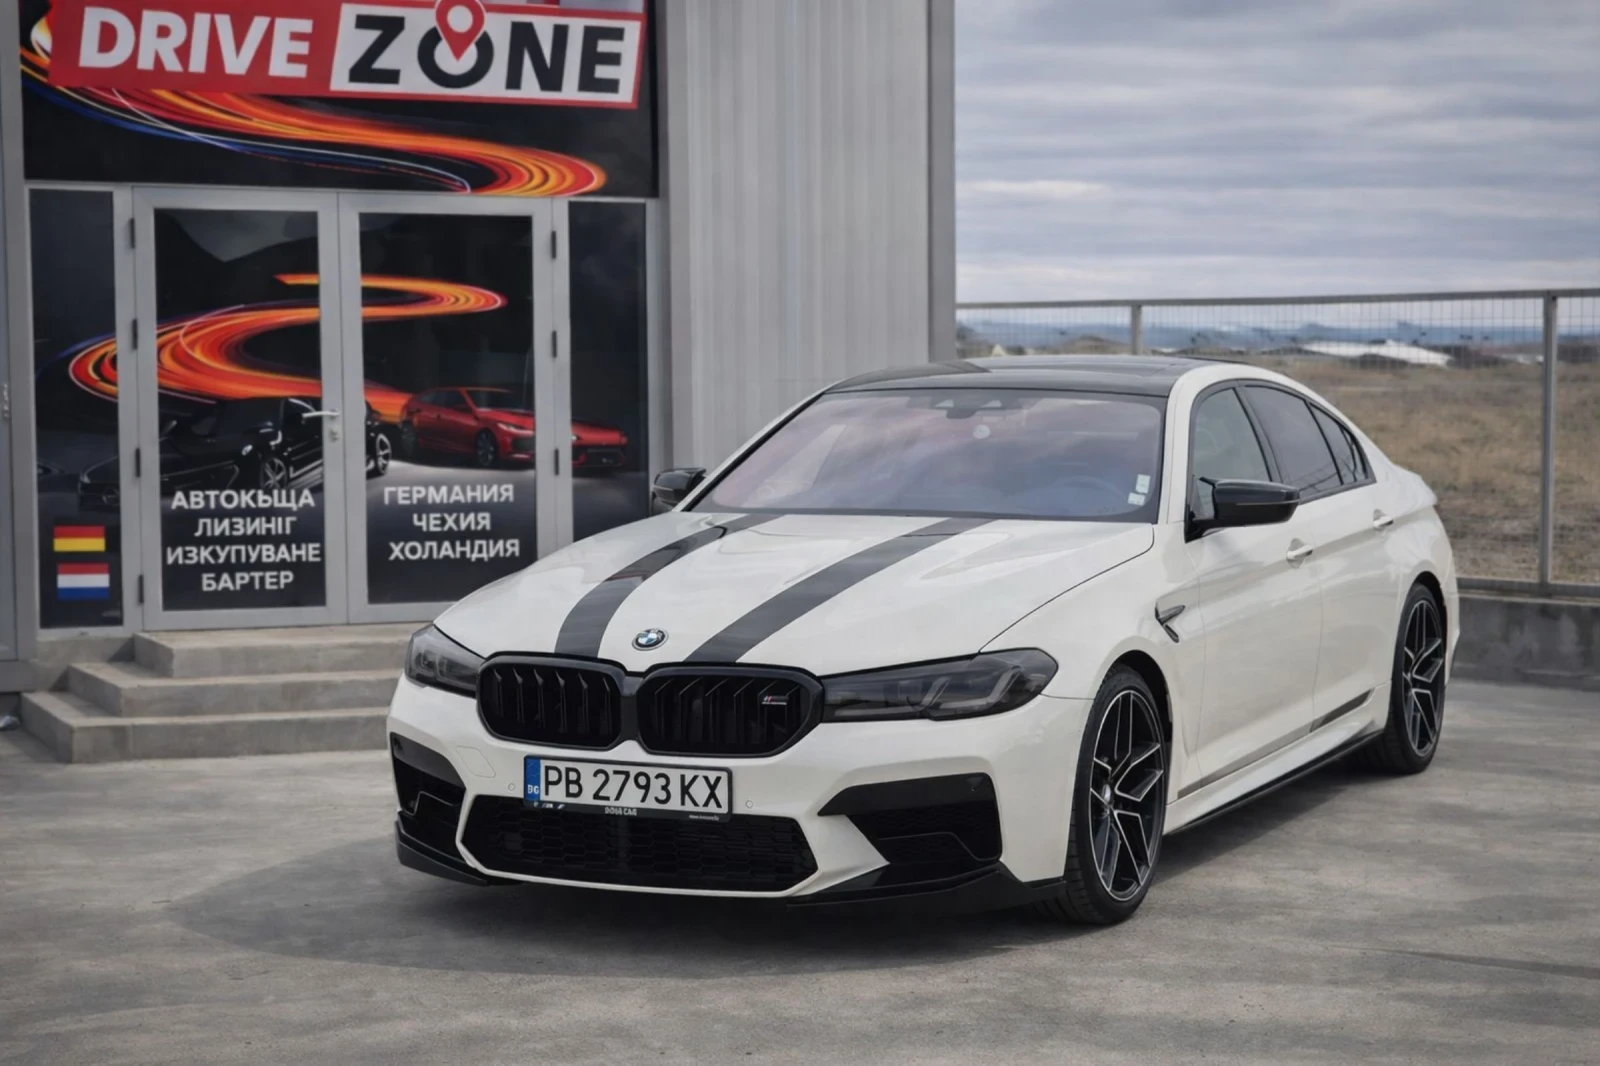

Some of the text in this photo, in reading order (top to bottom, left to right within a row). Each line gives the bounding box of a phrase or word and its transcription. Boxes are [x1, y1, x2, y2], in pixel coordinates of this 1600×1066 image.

[78, 6, 626, 94] DRIVE ZONE
[384, 484, 514, 505] ГЕРМАНИЯ
[413, 512, 491, 532] ЧЕХИЯ
[166, 543, 321, 565] ИЗКУПУВАНЕ
[388, 539, 520, 562] ХОЛАНДИЯ
[202, 570, 294, 591] БАРТЕР
[544, 765, 722, 808] PB 2793 KX
